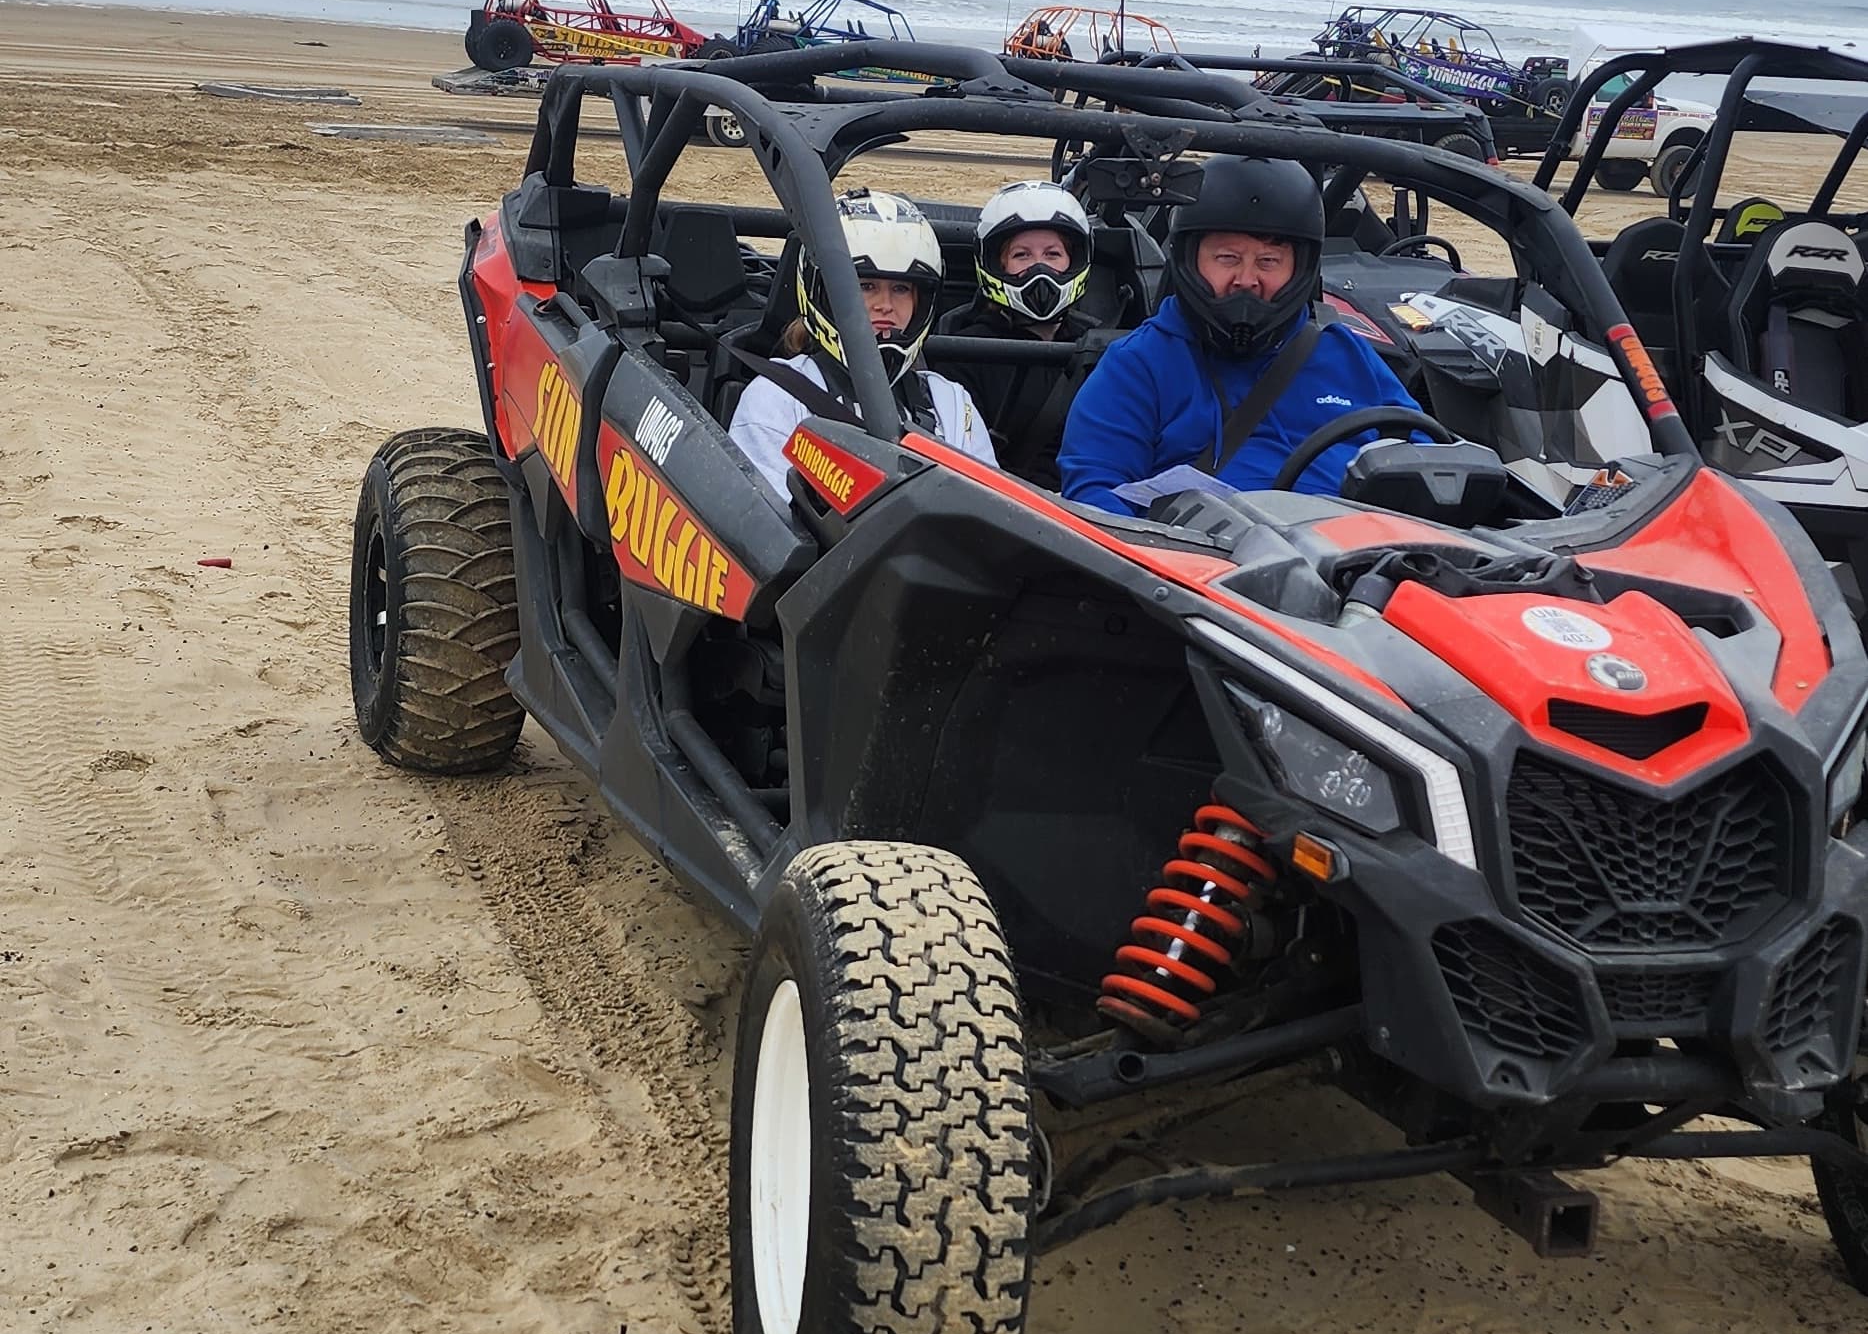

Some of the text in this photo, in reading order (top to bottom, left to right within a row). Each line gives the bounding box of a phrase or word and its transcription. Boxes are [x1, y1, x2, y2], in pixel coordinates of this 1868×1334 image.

[1425, 65, 1497, 91] SUNBUGGY
[1640, 250, 1680, 262] RZ
[1786, 245, 1850, 262] RZR
[1440, 313, 1504, 359] RZR
[1316, 394, 1352, 406] adidas
[533, 360, 582, 489] SUN
[635, 395, 684, 466] UM403
[1713, 407, 1802, 463] XP
[791, 431, 854, 504] SUNBUGGIE
[605, 449, 729, 615] BUGGIE
[1530, 608, 1561, 619] UM
[1562, 634, 1593, 645] 403
[1616, 670, 1643, 679] BRP
